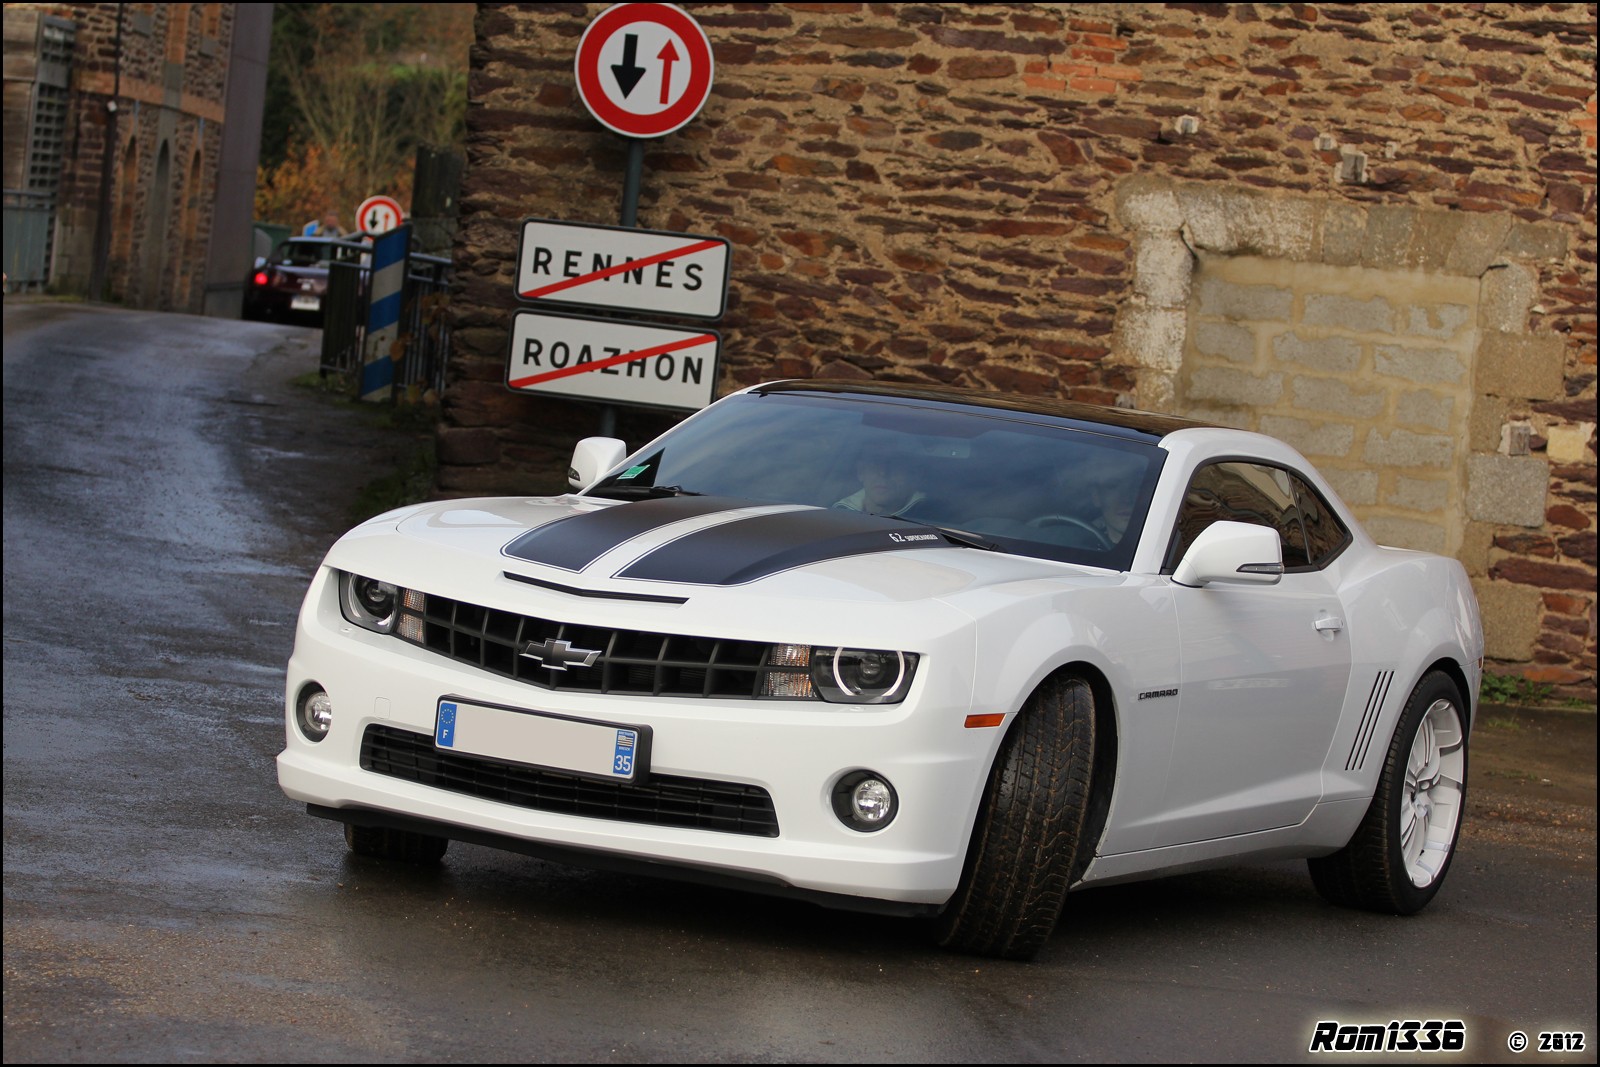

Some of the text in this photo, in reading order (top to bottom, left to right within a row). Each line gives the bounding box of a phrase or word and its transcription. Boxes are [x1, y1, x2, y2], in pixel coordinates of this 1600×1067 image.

[532, 247, 703, 291] RENNES
[523, 338, 703, 385] ROAZHON
[1138, 688, 1178, 701] CAMARO
[442, 729, 449, 739] F
[614, 754, 631, 772] 35
